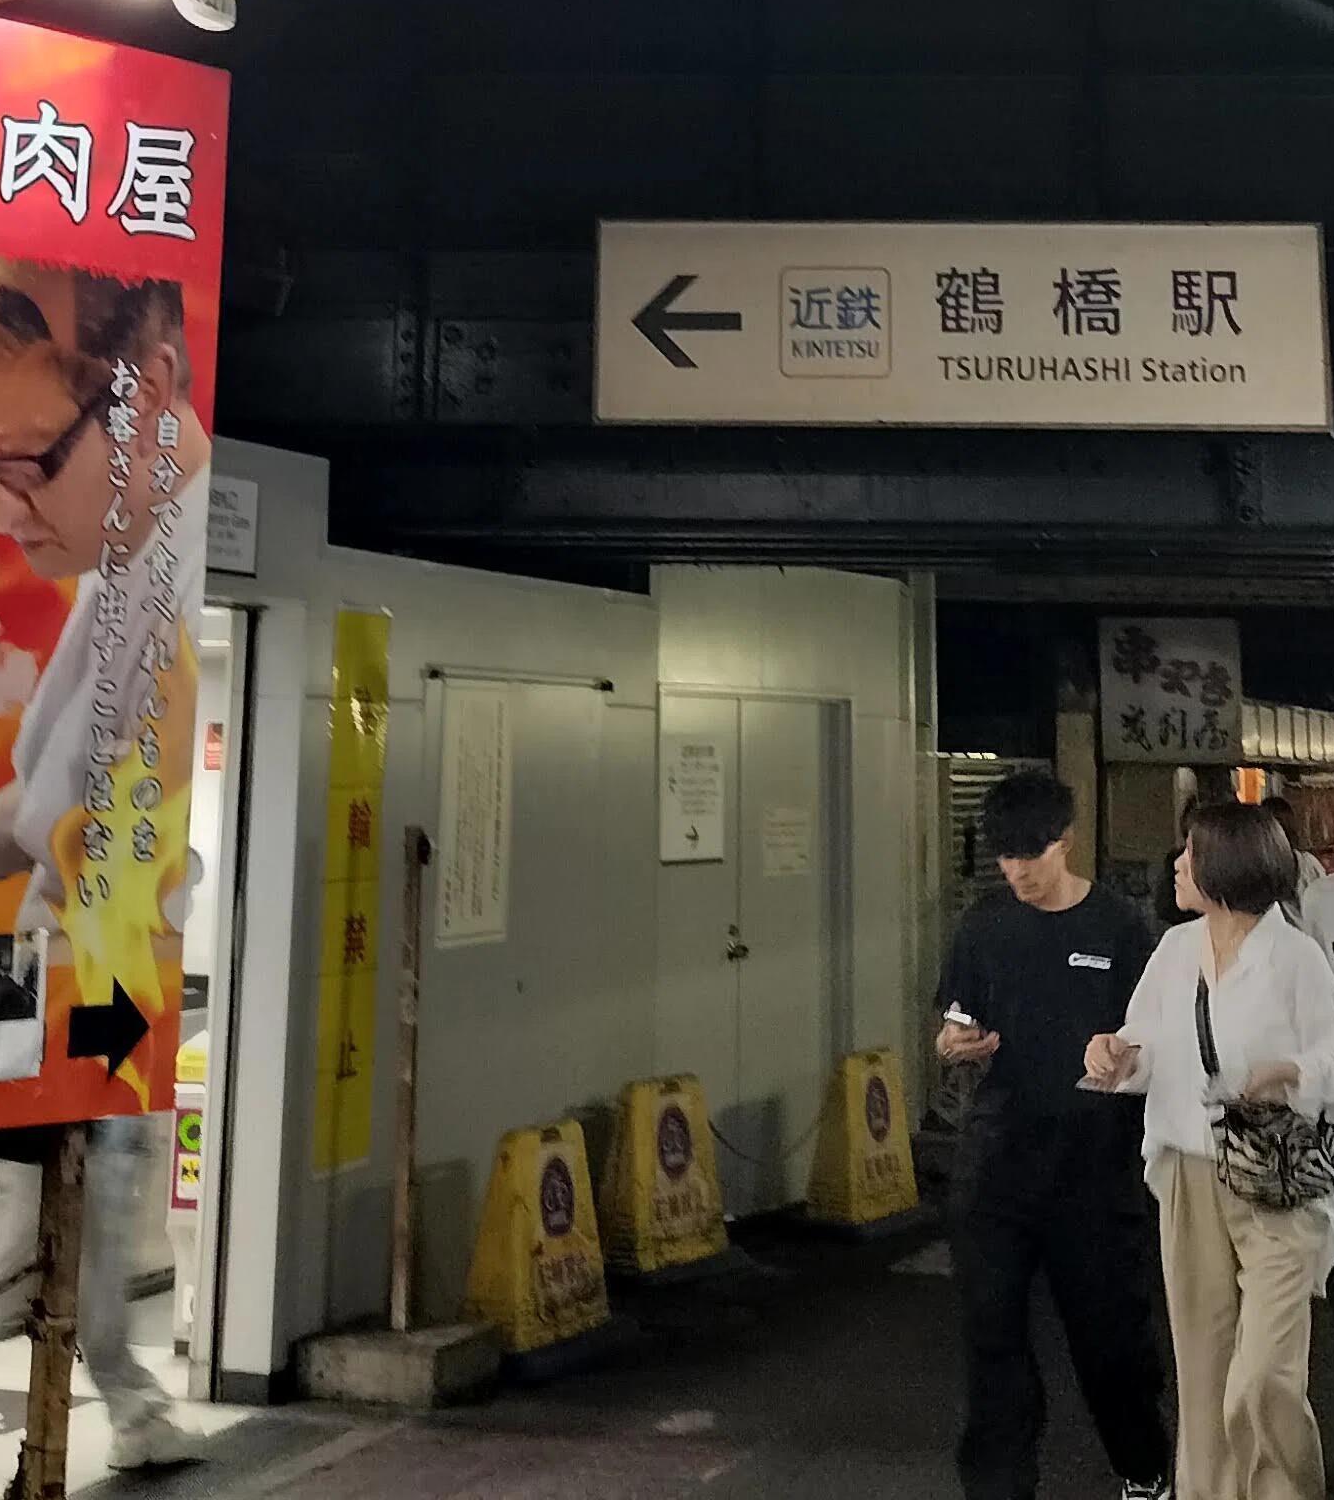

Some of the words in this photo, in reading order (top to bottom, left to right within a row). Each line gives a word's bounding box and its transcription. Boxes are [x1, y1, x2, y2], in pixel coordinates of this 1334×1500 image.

[788, 284, 880, 333] 近鉄
[935, 266, 1244, 338] 鶴橋駅
[790, 340, 882, 359] KINTETSU
[938, 356, 1133, 384] TSURUHASHI
[1140, 357, 1247, 384] Station
